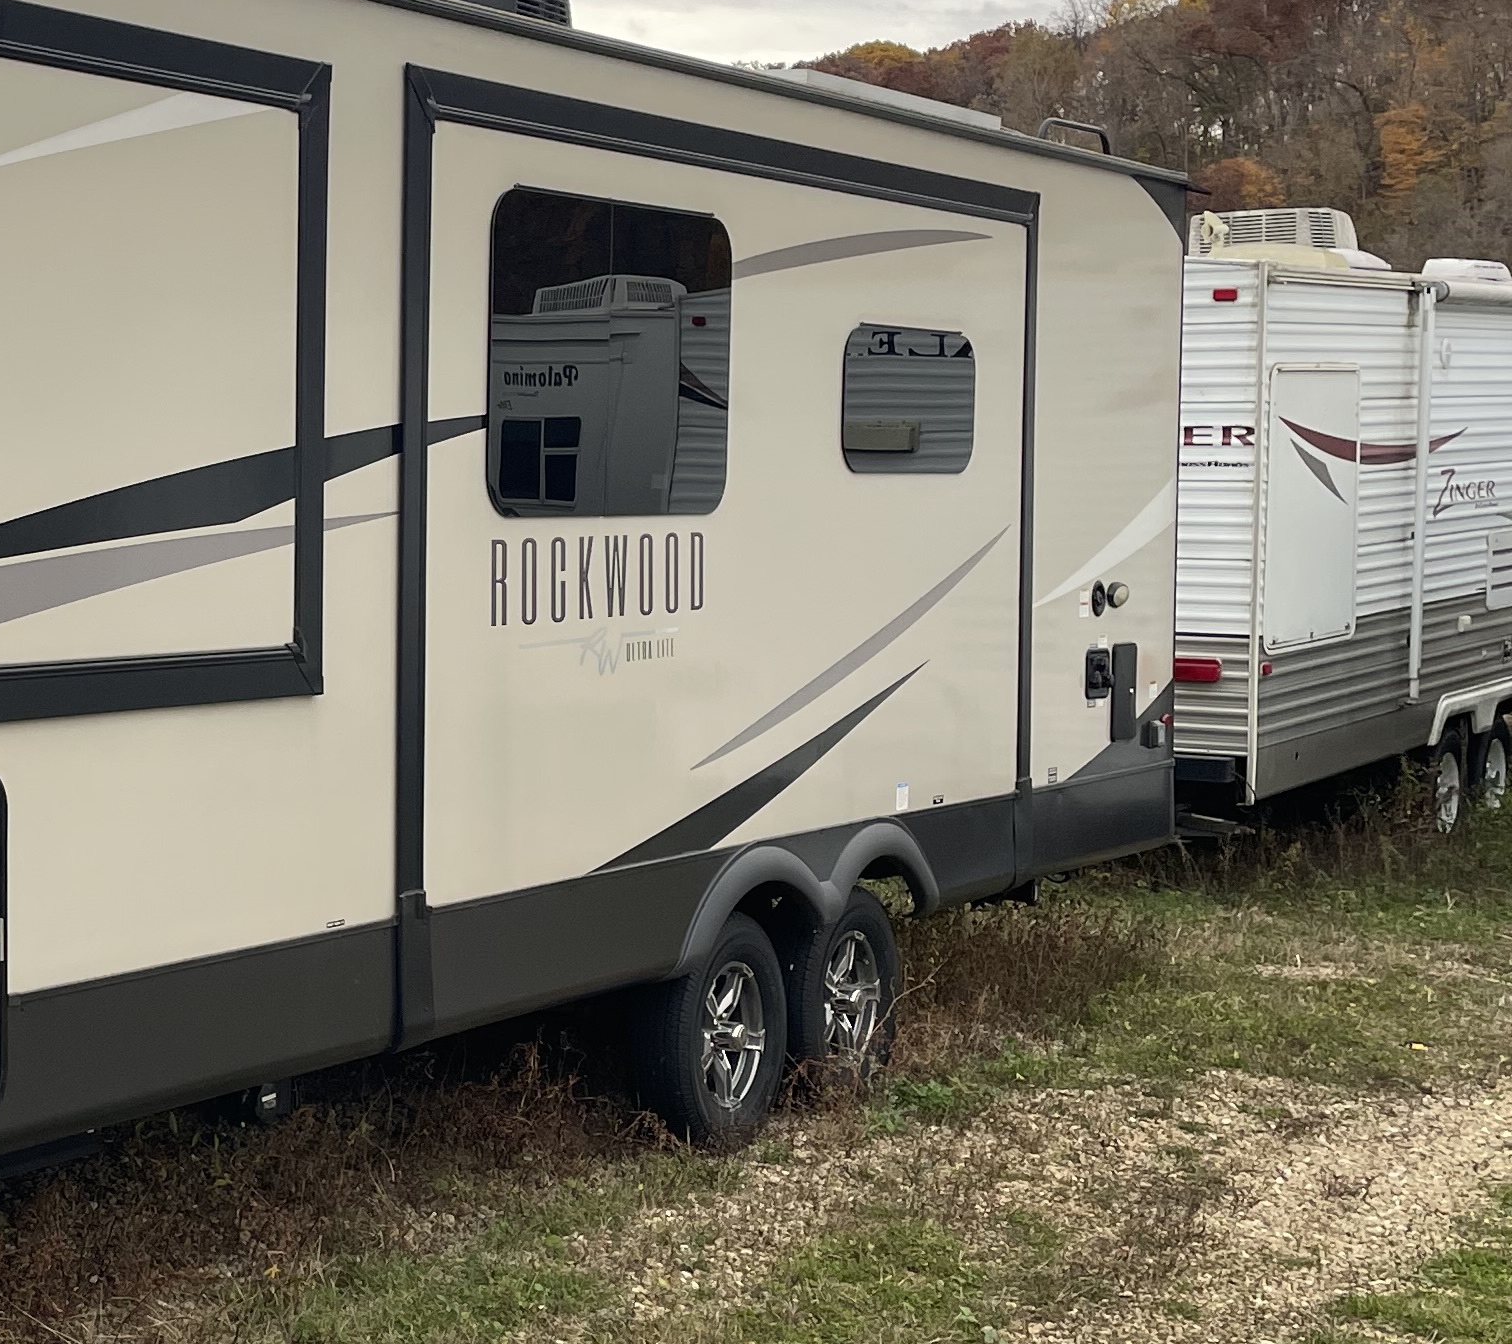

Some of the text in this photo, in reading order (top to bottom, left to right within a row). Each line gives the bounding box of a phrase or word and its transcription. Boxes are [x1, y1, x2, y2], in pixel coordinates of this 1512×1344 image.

[1183, 425, 1255, 446] ER
[491, 532, 704, 627] ROCKWOOD
[626, 640, 653, 662] ULTRA
[656, 637, 675, 659] LITE
